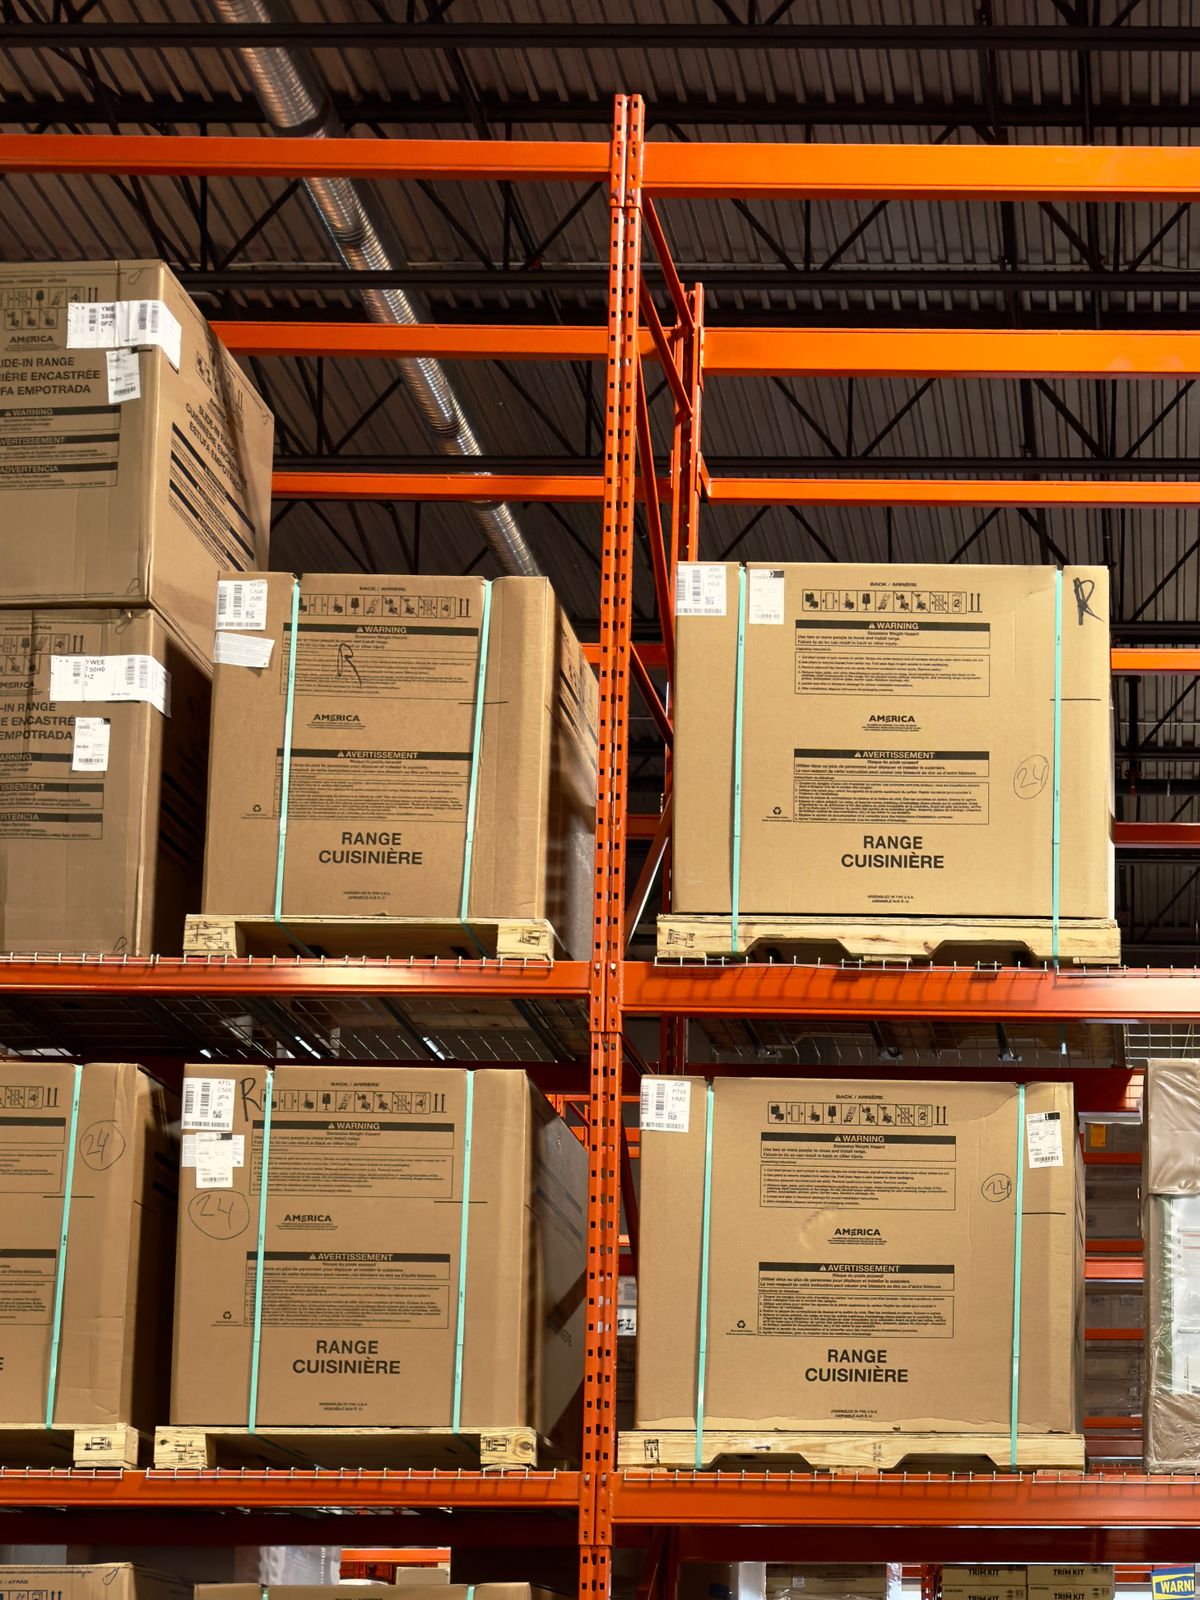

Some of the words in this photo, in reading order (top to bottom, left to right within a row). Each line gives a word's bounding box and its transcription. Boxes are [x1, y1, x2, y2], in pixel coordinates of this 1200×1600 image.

[36, 356, 75, 367] RANGE
[31, 369, 100, 381] ENCASTRÉE
[17, 384, 91, 395] EMPOTRADA
[1074, 577, 1105, 626] R
[365, 626, 407, 634] WARNING
[877, 622, 919, 630] WARNING
[18, 702, 57, 712] RANGE
[12, 716, 76, 726] ENCASTRÉ
[313, 714, 360, 722] AMERICA
[869, 715, 915, 723] AMERICA
[346, 751, 419, 760] AVERTISSEMENT
[862, 751, 935, 759] AVERTISSEMENT
[341, 832, 401, 847] RANGE
[863, 835, 923, 849] RANGE
[318, 848, 422, 866] CUISINIÈRE
[841, 852, 944, 869] CUISINIÈRE
[240, 1077, 262, 1122] R
[336, 1122, 380, 1130] WARNING
[843, 1135, 885, 1143] WARNING
[284, 1214, 332, 1222] AMERICA
[834, 1228, 881, 1236] AMERICA
[317, 1253, 393, 1262] AVERTISSEMENT
[828, 1264, 900, 1273] AVERTISSEMENT
[315, 1340, 378, 1355] RANGE
[827, 1349, 887, 1364] RANGE
[292, 1356, 400, 1375] CUISINIÈRE
[804, 1364, 908, 1384] CUISINIÈRE
